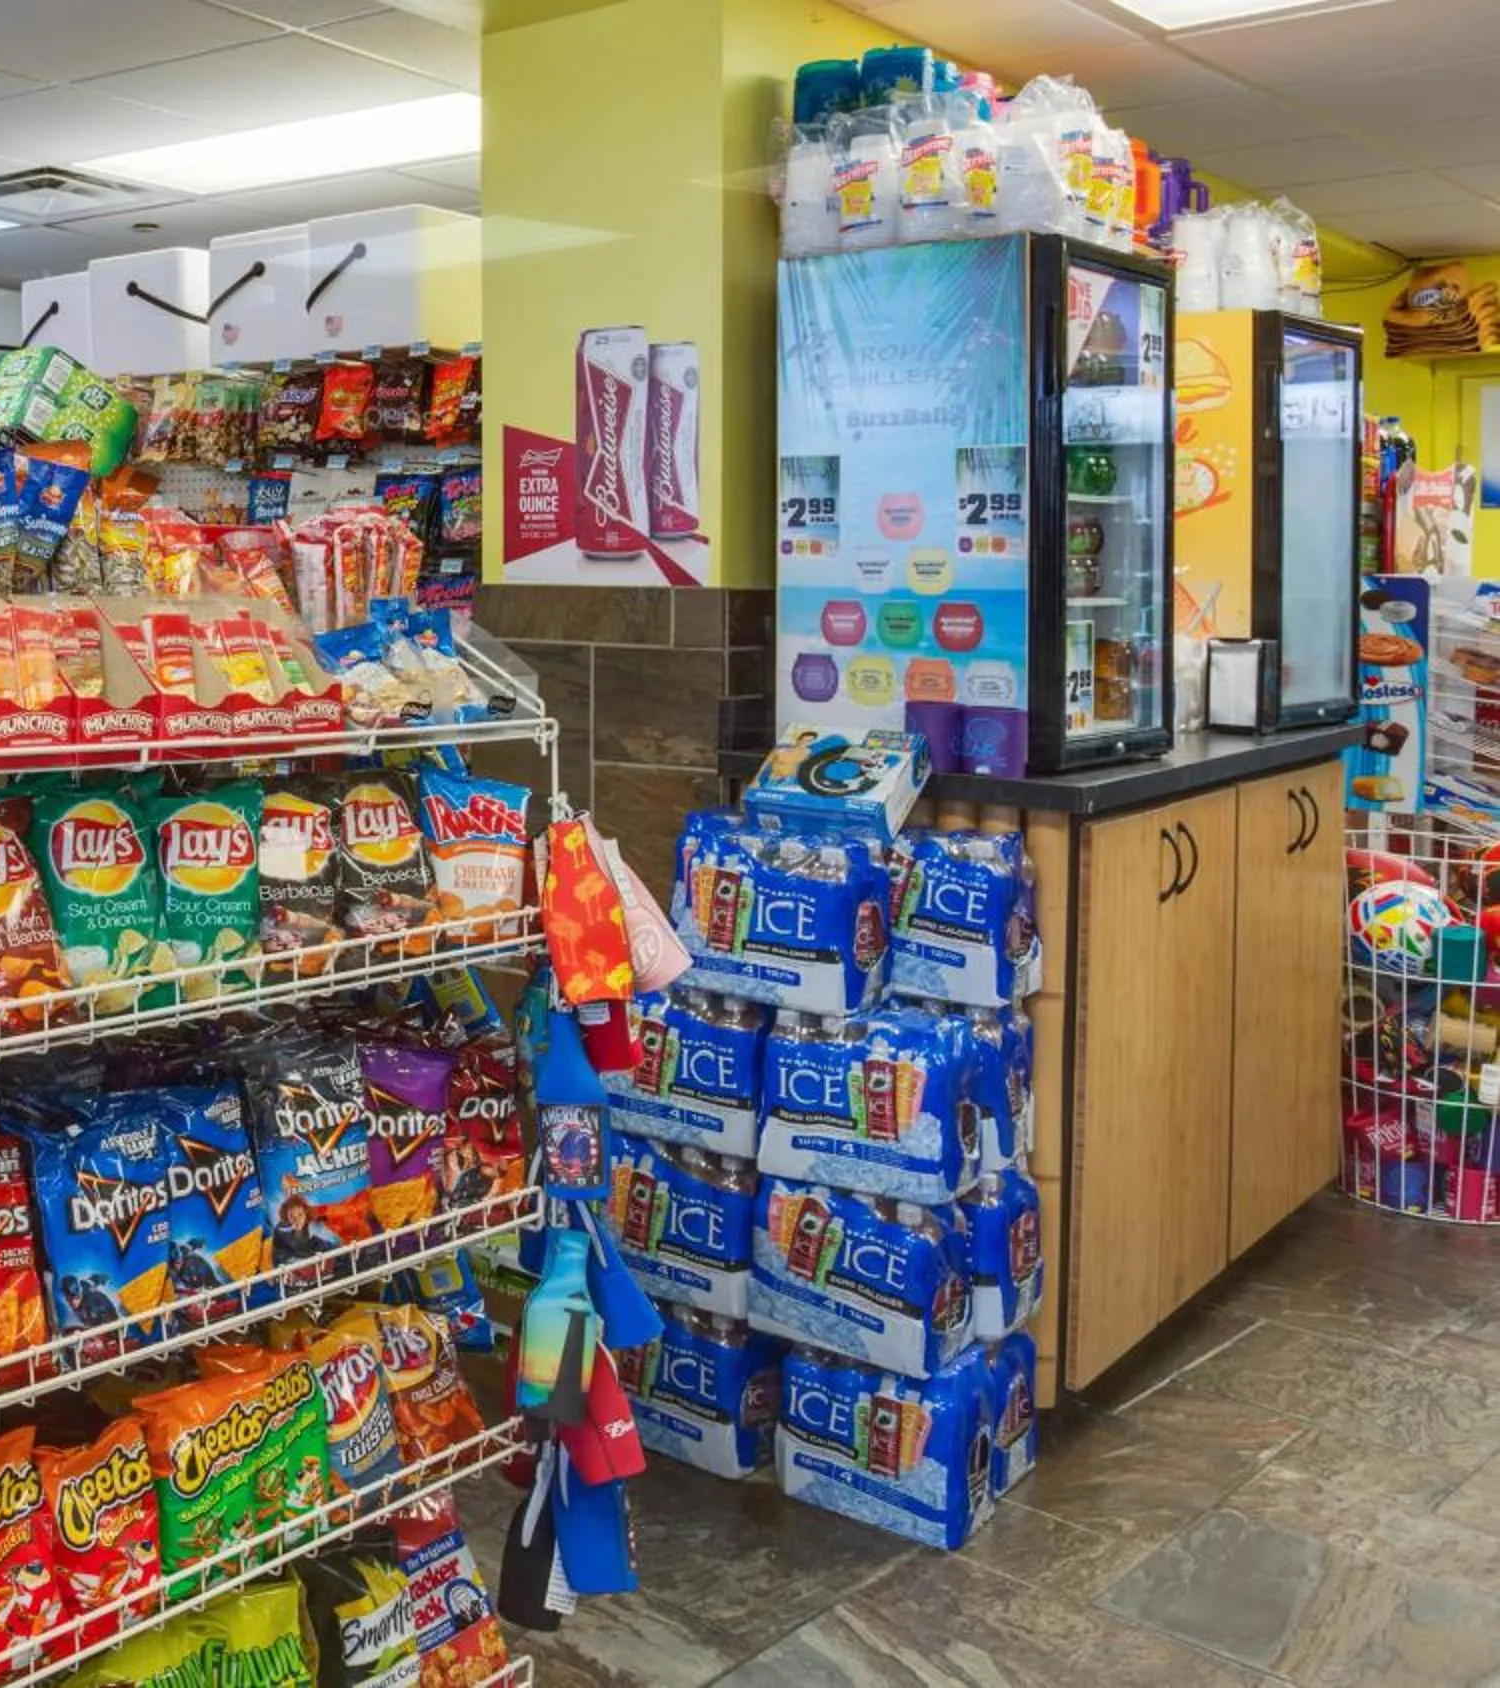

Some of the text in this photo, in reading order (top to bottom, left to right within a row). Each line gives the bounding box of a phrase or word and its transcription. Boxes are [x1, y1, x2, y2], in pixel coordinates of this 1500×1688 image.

[519, 477, 558, 493] EXTRA
[519, 495, 560, 512] OUNCE
[1364, 684, 1422, 699] ostess
[83, 711, 152, 736] MUNCHIES
[166, 712, 232, 737] MUNCHIES
[233, 709, 292, 732] MUNCHIES
[294, 702, 340, 722] UNCHIES
[60, 815, 135, 870] Lay's
[167, 821, 253, 867] Lay's
[260, 884, 335, 901] Barbecue
[362, 866, 430, 887] Barbecue
[67, 897, 148, 918] Sour Cream
[97, 913, 136, 929] Onion
[167, 897, 251, 914] Sour Cream
[194, 911, 237, 927] Onion
[755, 895, 817, 942] ICE
[924, 879, 988, 925] ICE
[680, 1046, 738, 1089] ICE
[778, 1066, 844, 1109] ICE
[459, 1093, 516, 1120] Dori
[168, 1151, 255, 1199] Doritos
[71, 1180, 169, 1231] Doritos
[669, 1200, 725, 1250] ICE
[840, 1238, 907, 1290] ICE
[263, 1360, 315, 1413] eetos
[662, 1352, 717, 1400] ICE
[788, 1383, 851, 1437] ICE
[171, 1400, 265, 1498] Cheetos
[57, 1444, 152, 1552] Cheetos
[419, 1535, 456, 1563] Original
[341, 1586, 414, 1659] Smartfo
[412, 1594, 448, 1631] ack
